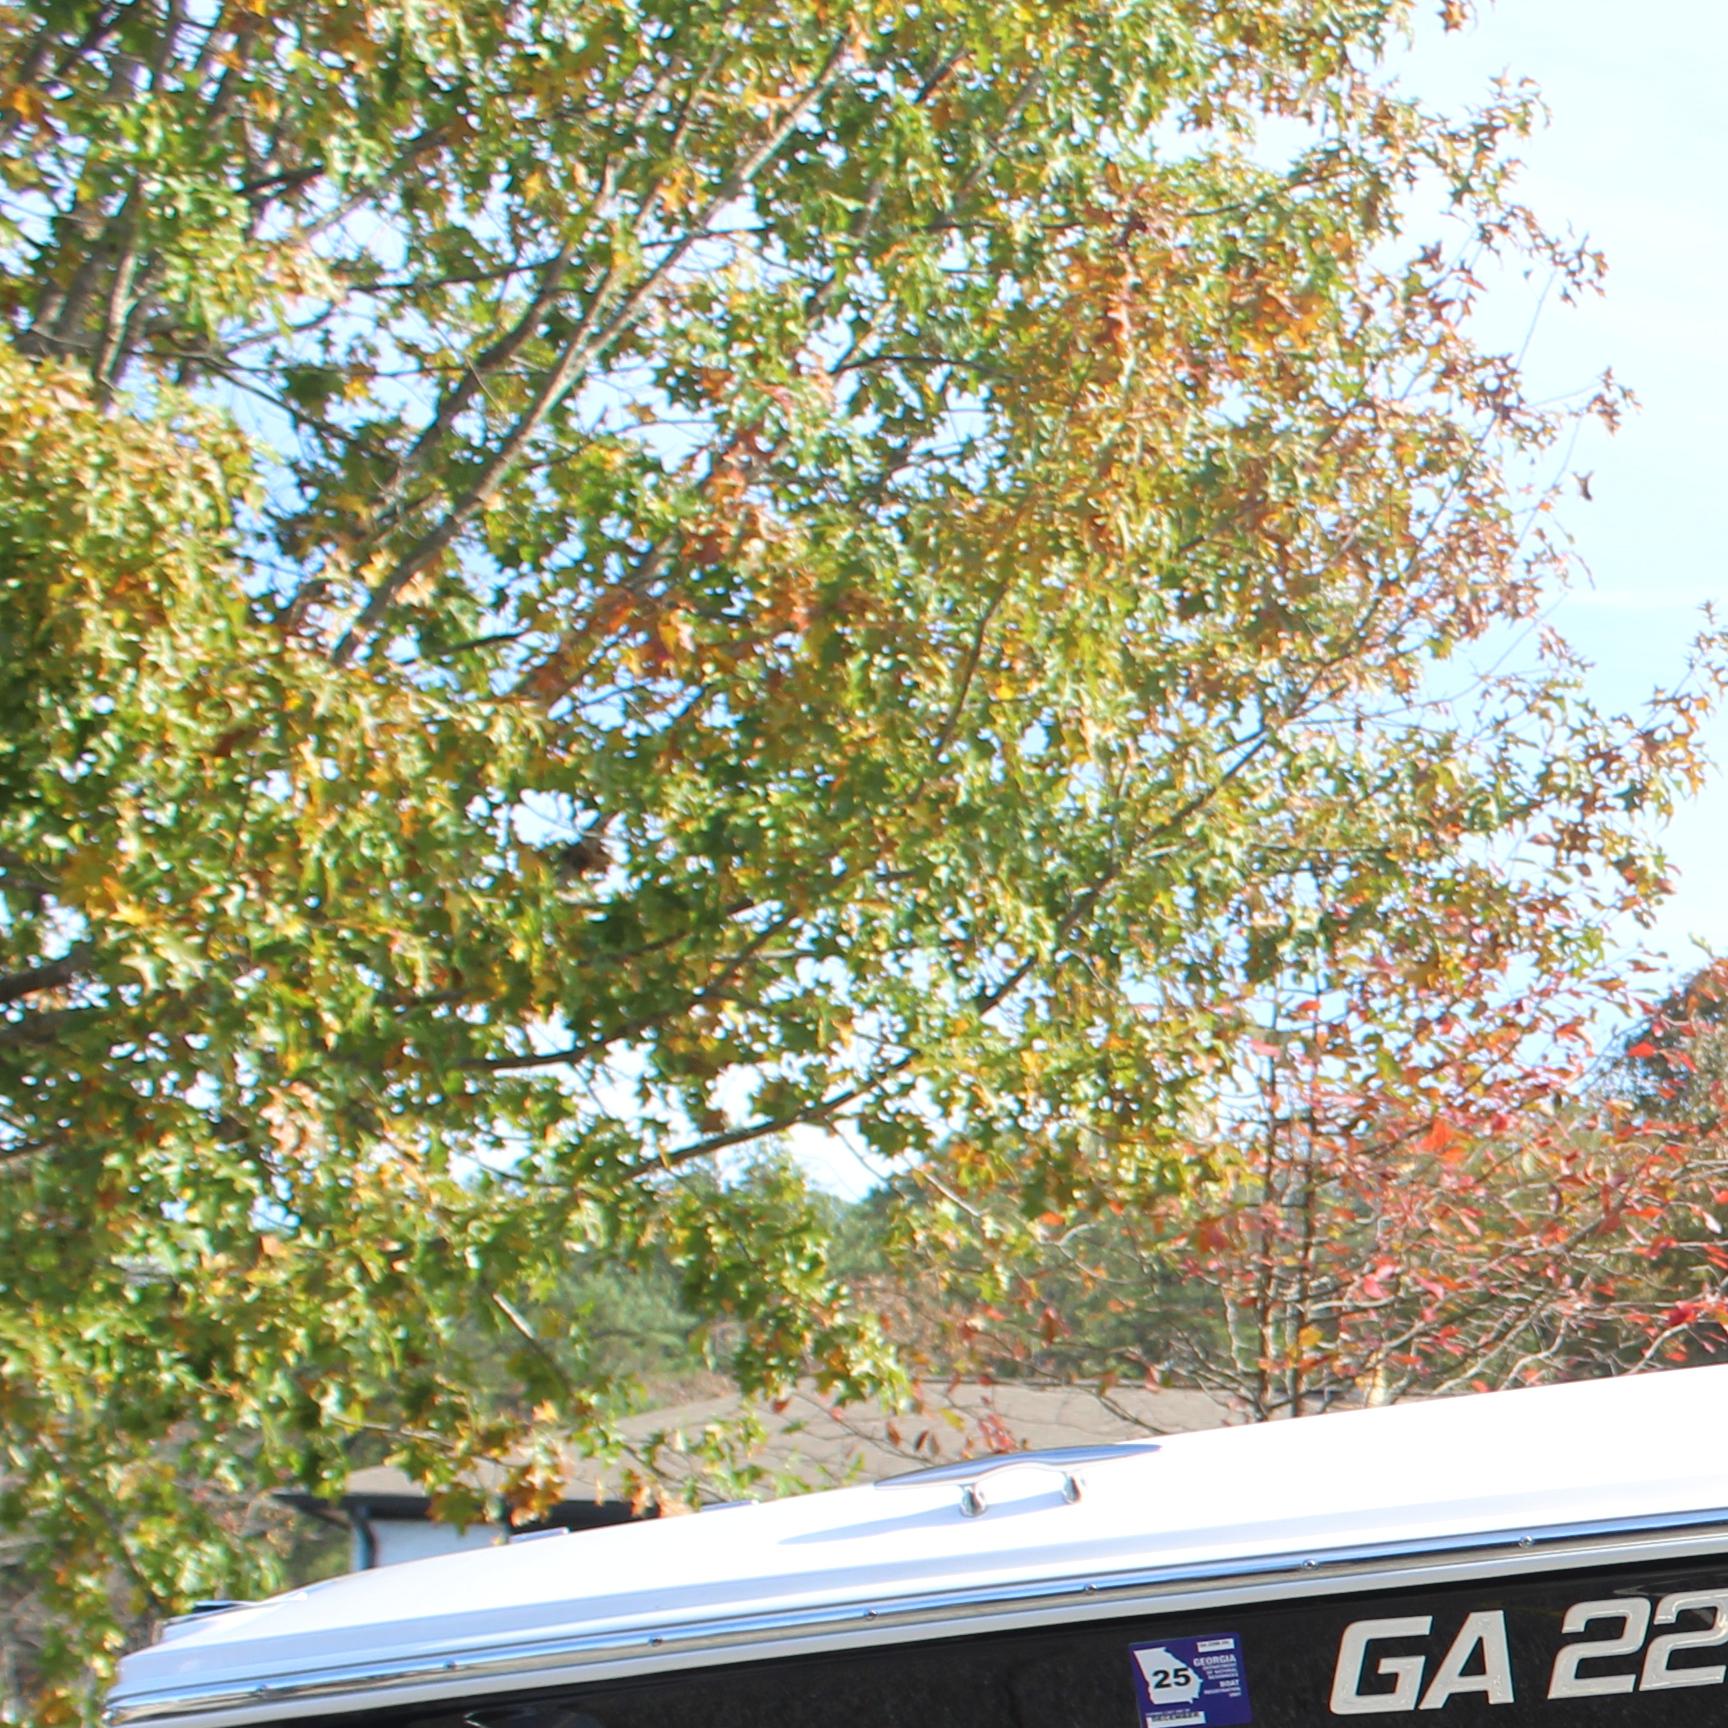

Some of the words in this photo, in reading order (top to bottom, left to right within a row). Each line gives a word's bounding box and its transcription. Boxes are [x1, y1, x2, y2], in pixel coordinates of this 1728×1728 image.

[1193, 1653, 1237, 1667] GEORGIA
[1329, 1609, 1516, 1716] GA
[1152, 1666, 1193, 1689] 25
